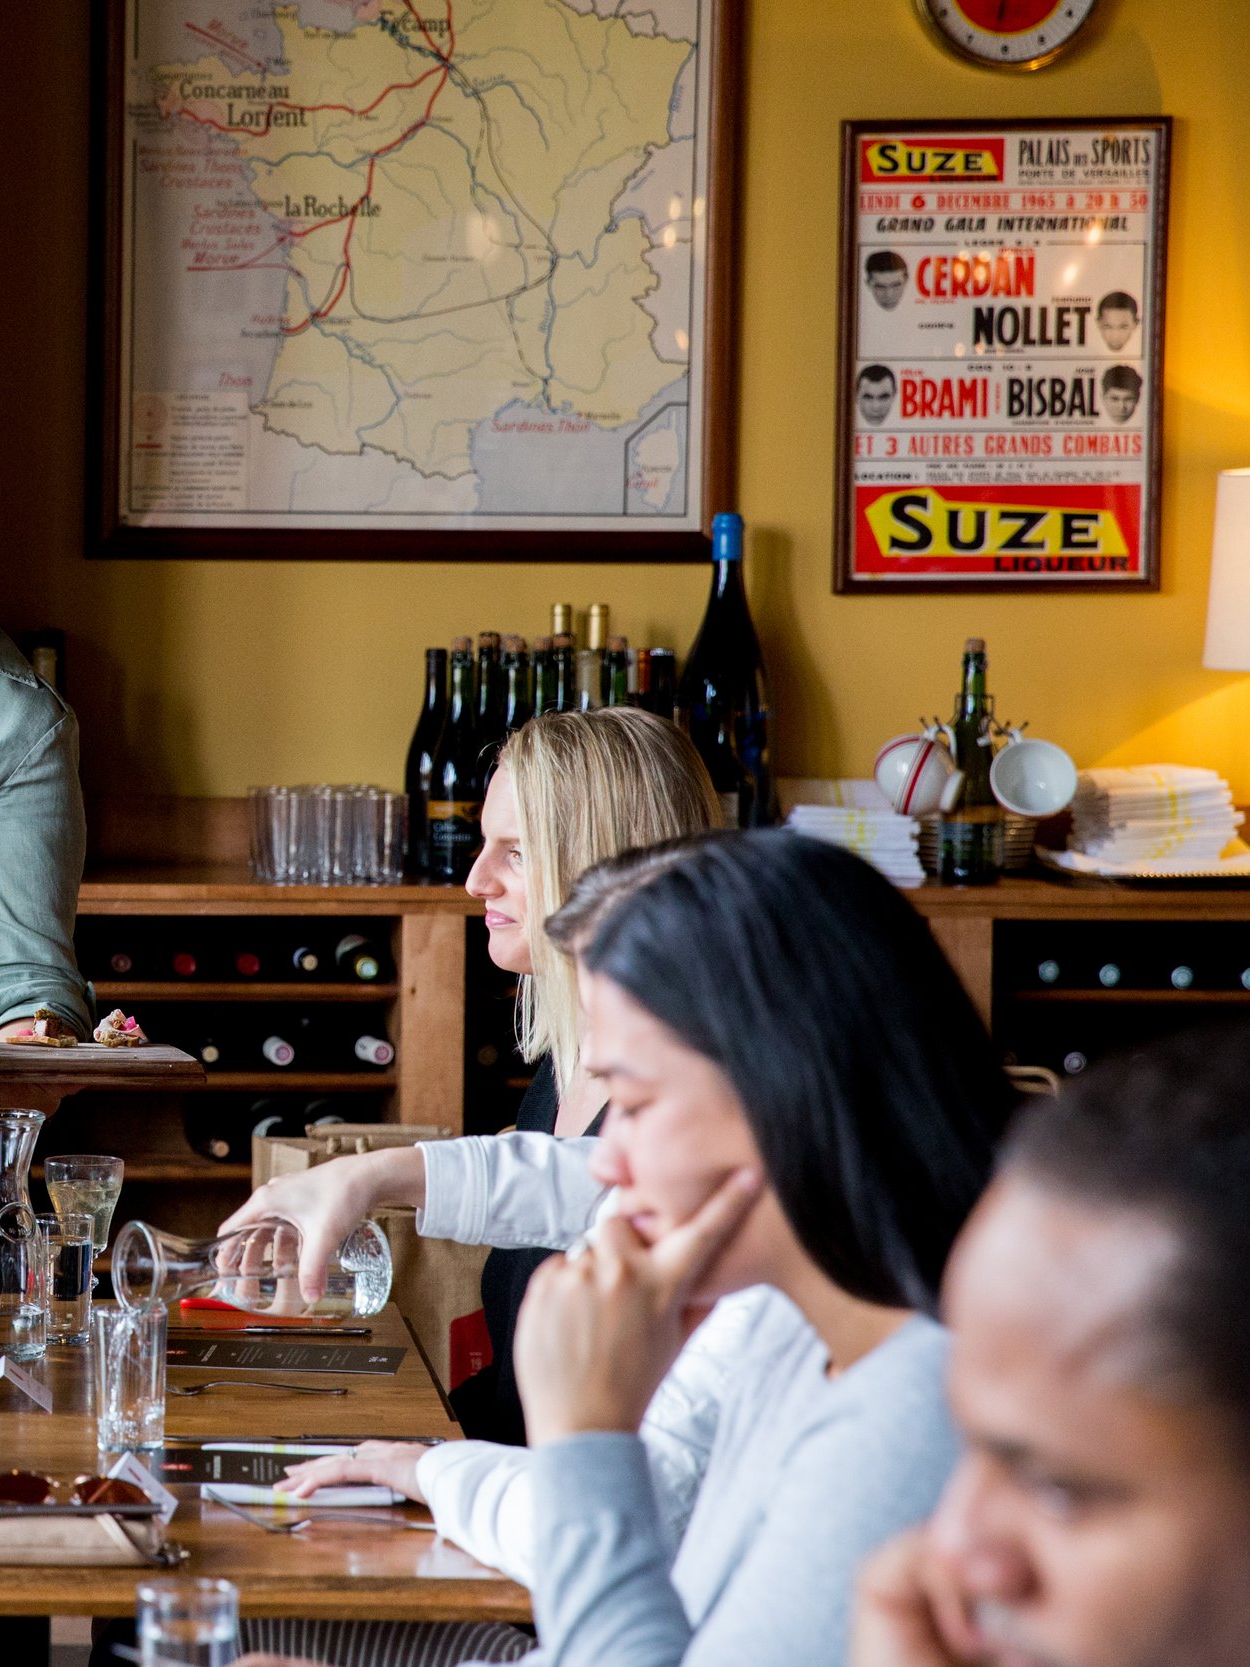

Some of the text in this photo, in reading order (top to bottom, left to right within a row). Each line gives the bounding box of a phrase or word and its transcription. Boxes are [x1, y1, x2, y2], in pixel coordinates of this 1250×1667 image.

[179, 79, 290, 100] Concarneau
[876, 143, 984, 173] SUZE
[1018, 137, 1071, 167] PALAIS
[1091, 137, 1150, 167] SPORTS
[911, 193, 926, 210] 6
[876, 217, 935, 233] GRAND
[944, 216, 987, 232] GALA
[916, 256, 1035, 298] CERDAN
[972, 305, 1091, 347] NOLLET
[901, 377, 1100, 419] BRAMI BISBAL
[854, 433, 1143, 456] ET 3 AUTRES GRANDS COMBATS
[888, 494, 1100, 552] SUZE
[994, 556, 1128, 572] LIQUEUR
